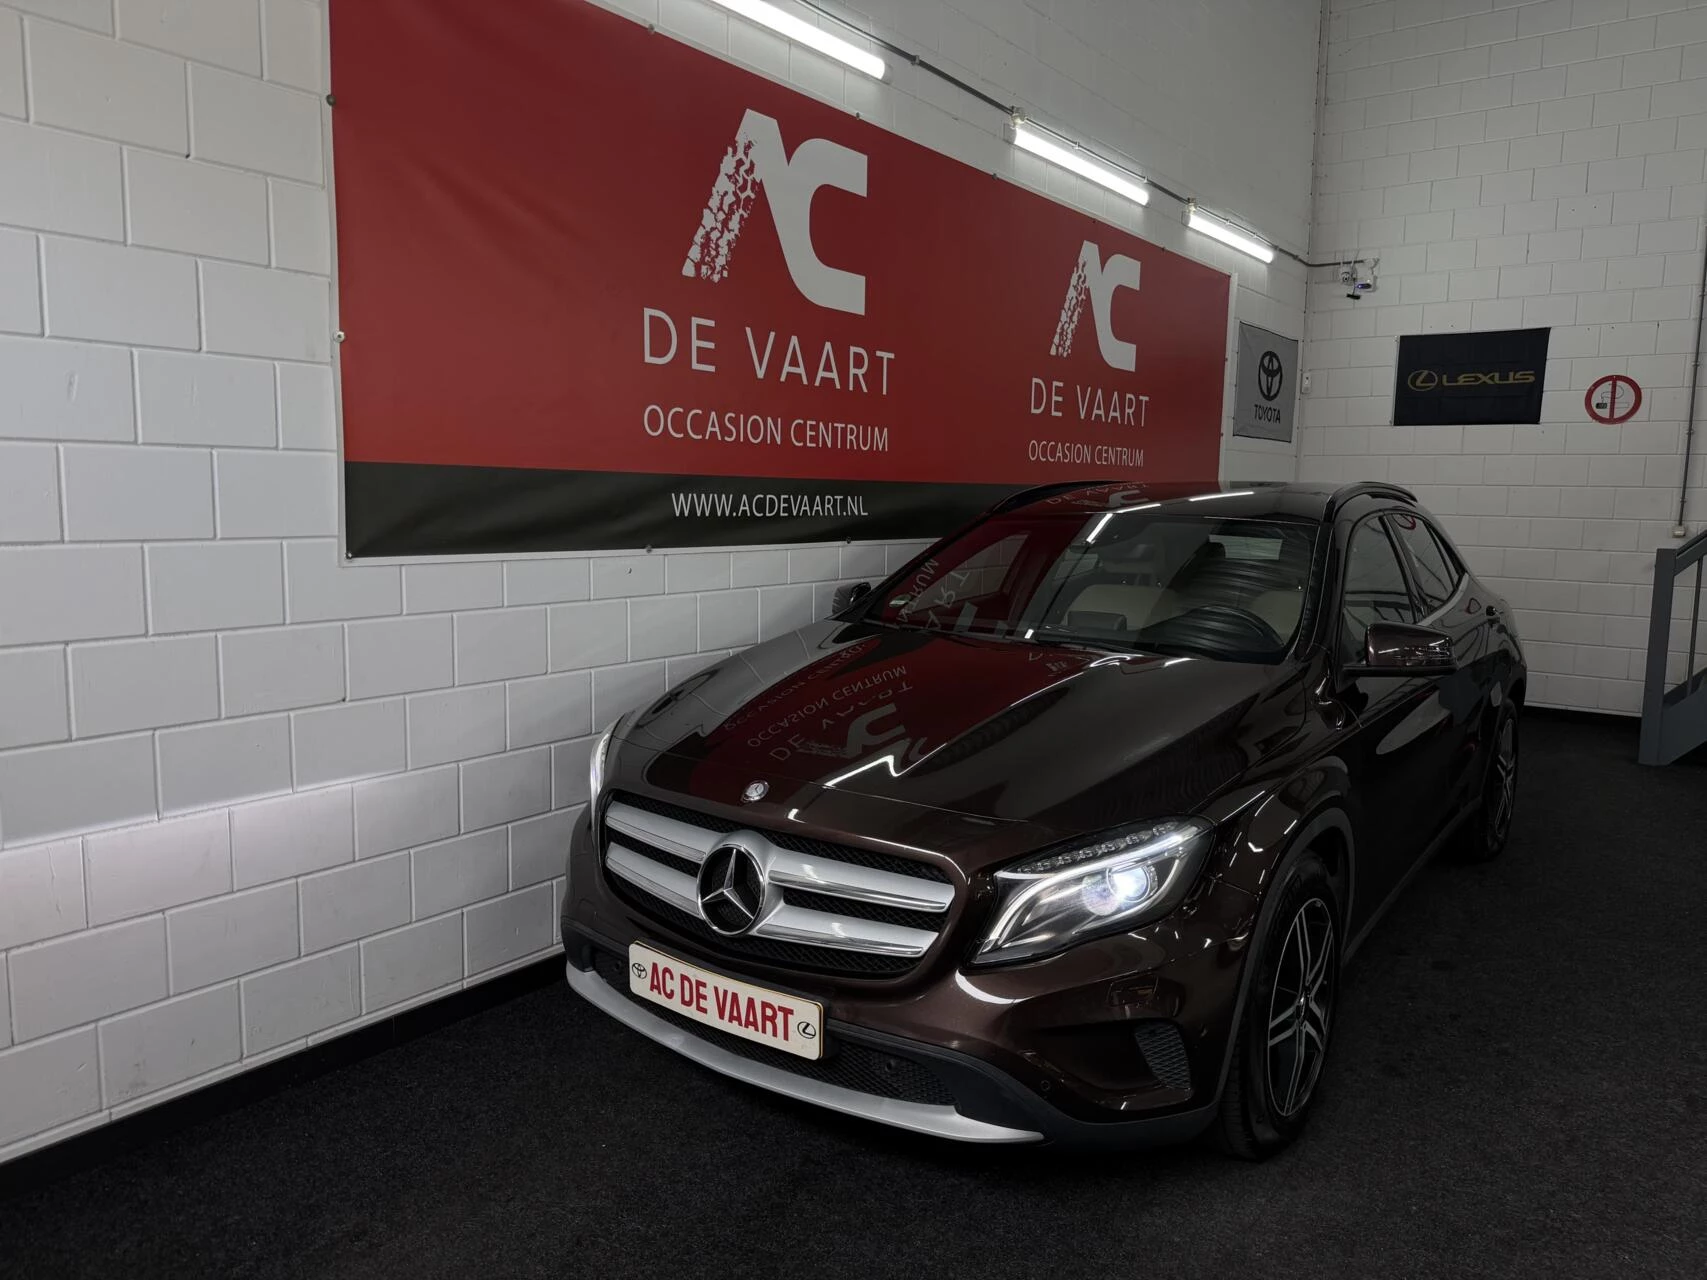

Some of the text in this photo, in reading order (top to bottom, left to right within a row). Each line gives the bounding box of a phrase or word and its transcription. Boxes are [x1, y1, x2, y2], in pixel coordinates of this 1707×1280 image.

[643, 307, 896, 395] DE VAART
[1441, 370, 1536, 386] LEXUS
[1030, 376, 1150, 428] DE VAART
[1253, 403, 1281, 425] TOYOTA
[643, 404, 889, 452] OCCASION CENTRUM
[1028, 439, 1144, 467] OCCASION CENTRUM
[671, 492, 869, 517] WWW.ACDEVAART.NL
[650, 961, 794, 1041] AC DE VAART
